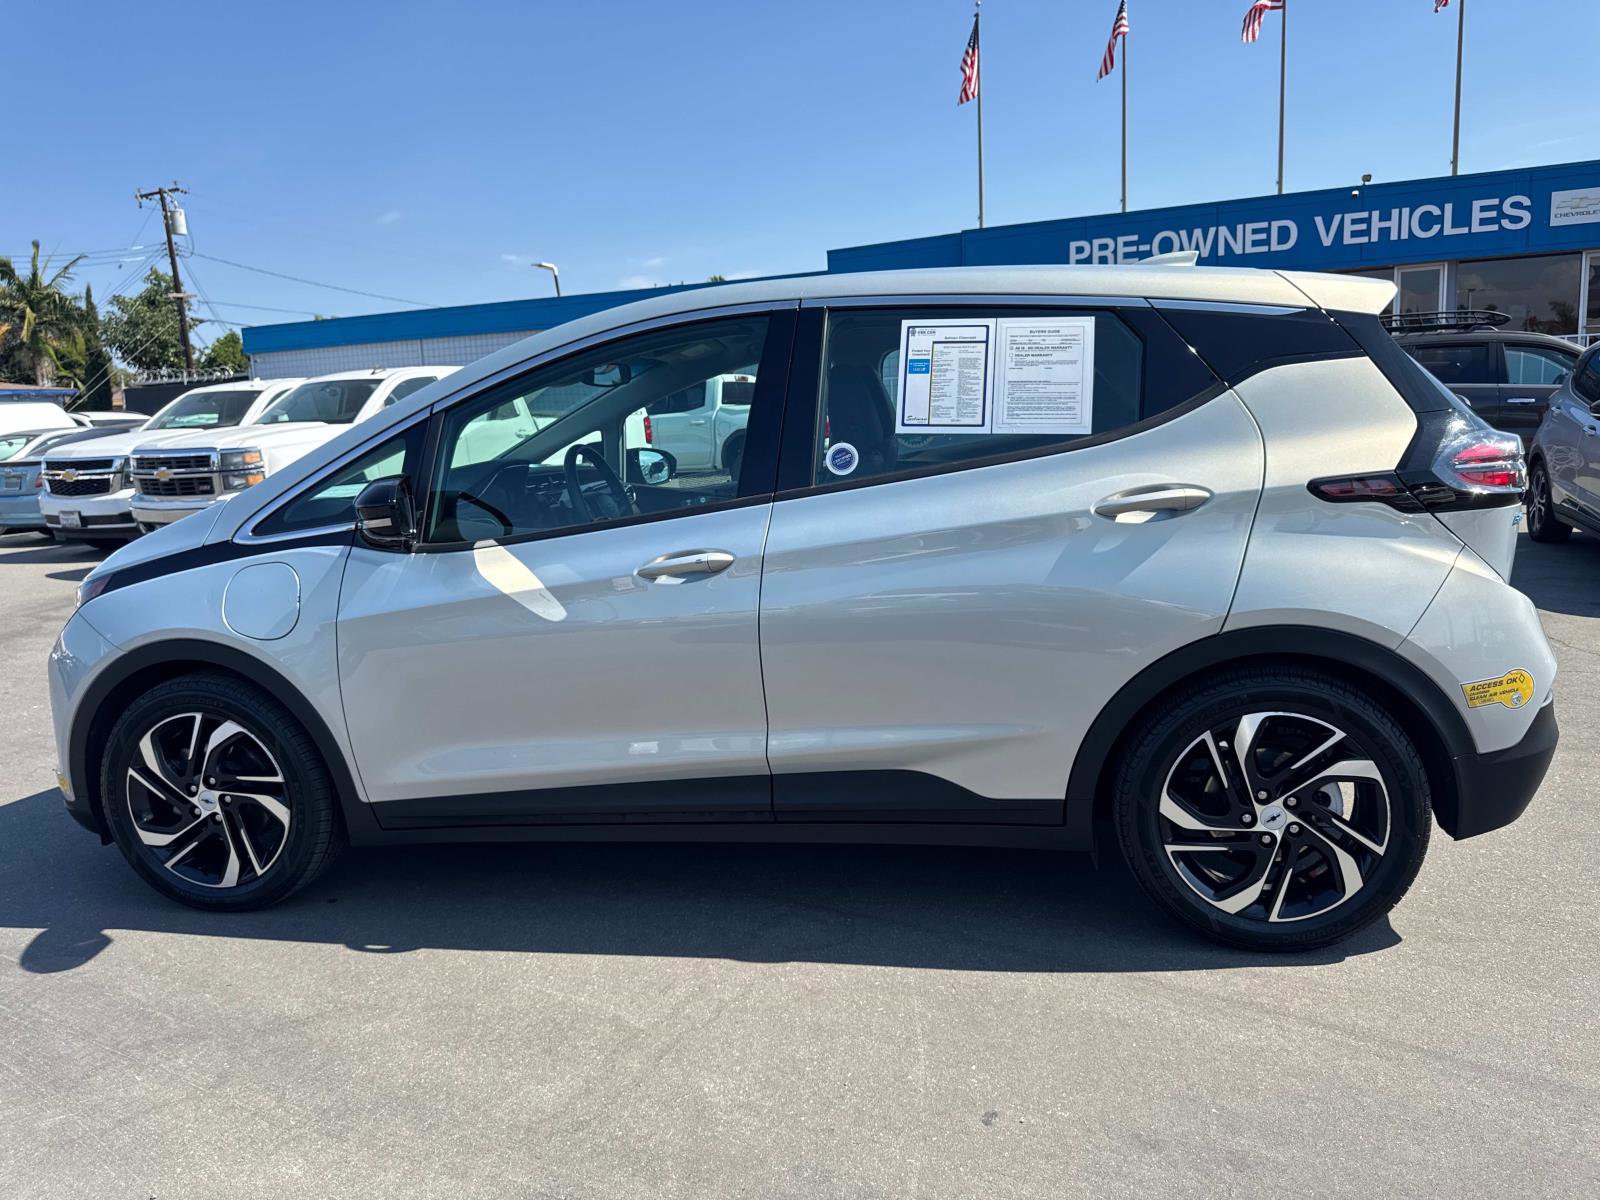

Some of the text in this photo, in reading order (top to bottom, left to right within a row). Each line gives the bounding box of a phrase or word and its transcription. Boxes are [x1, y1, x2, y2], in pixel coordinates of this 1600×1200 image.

[1554, 209, 1600, 218] CHEVROLE
[1069, 195, 1532, 265] PRE-OWNED VEHICLES
[1470, 680, 1503, 691] ACCESS
